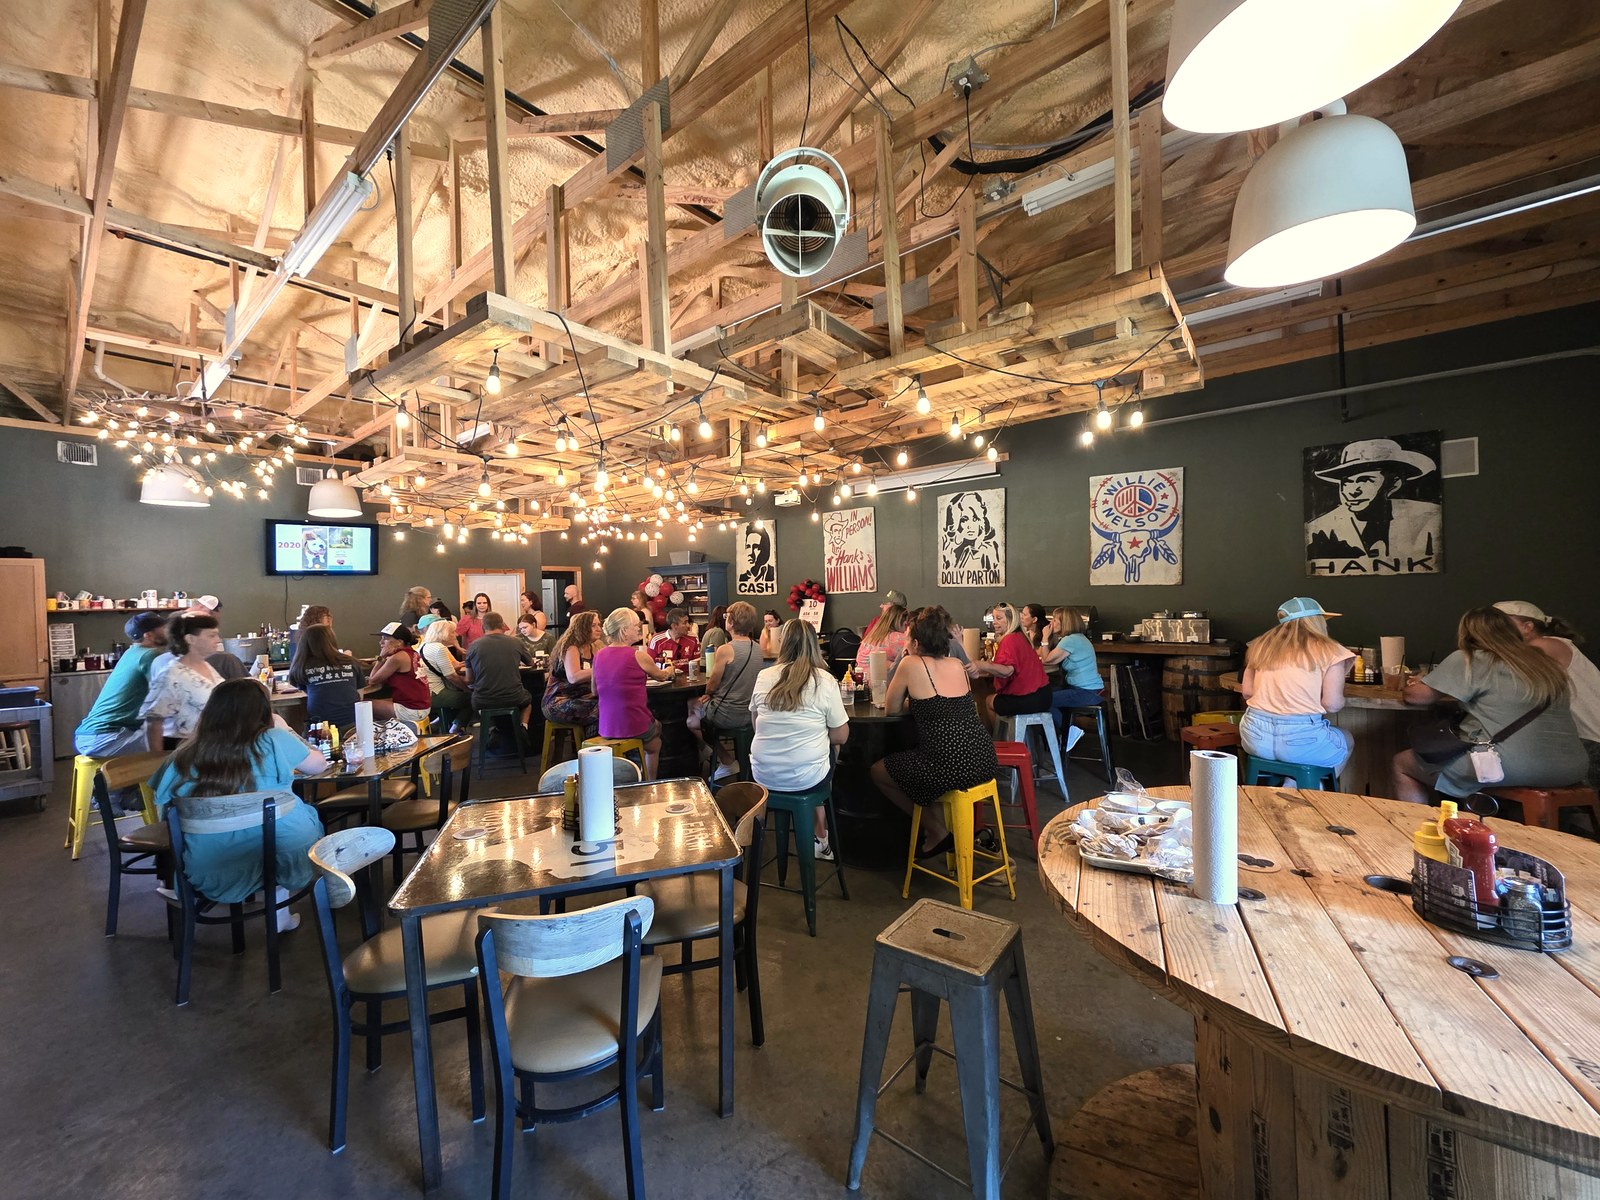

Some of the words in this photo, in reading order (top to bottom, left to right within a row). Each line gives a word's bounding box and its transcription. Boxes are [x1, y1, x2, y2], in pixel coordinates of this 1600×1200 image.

[1104, 475, 1166, 496] WILLIE
[850, 510, 858, 522] IN
[1102, 503, 1169, 528] NELSON
[845, 513, 873, 539] PERSON!
[278, 541, 301, 549] 2020
[1311, 557, 1433, 573] HANK
[826, 564, 875, 592] WILLIAMS
[941, 570, 965, 585] DOLLY
[966, 569, 1001, 585] PARTON
[738, 583, 775, 593] CASH
[809, 600, 817, 608] 10
[681, 820, 714, 851] FARM
